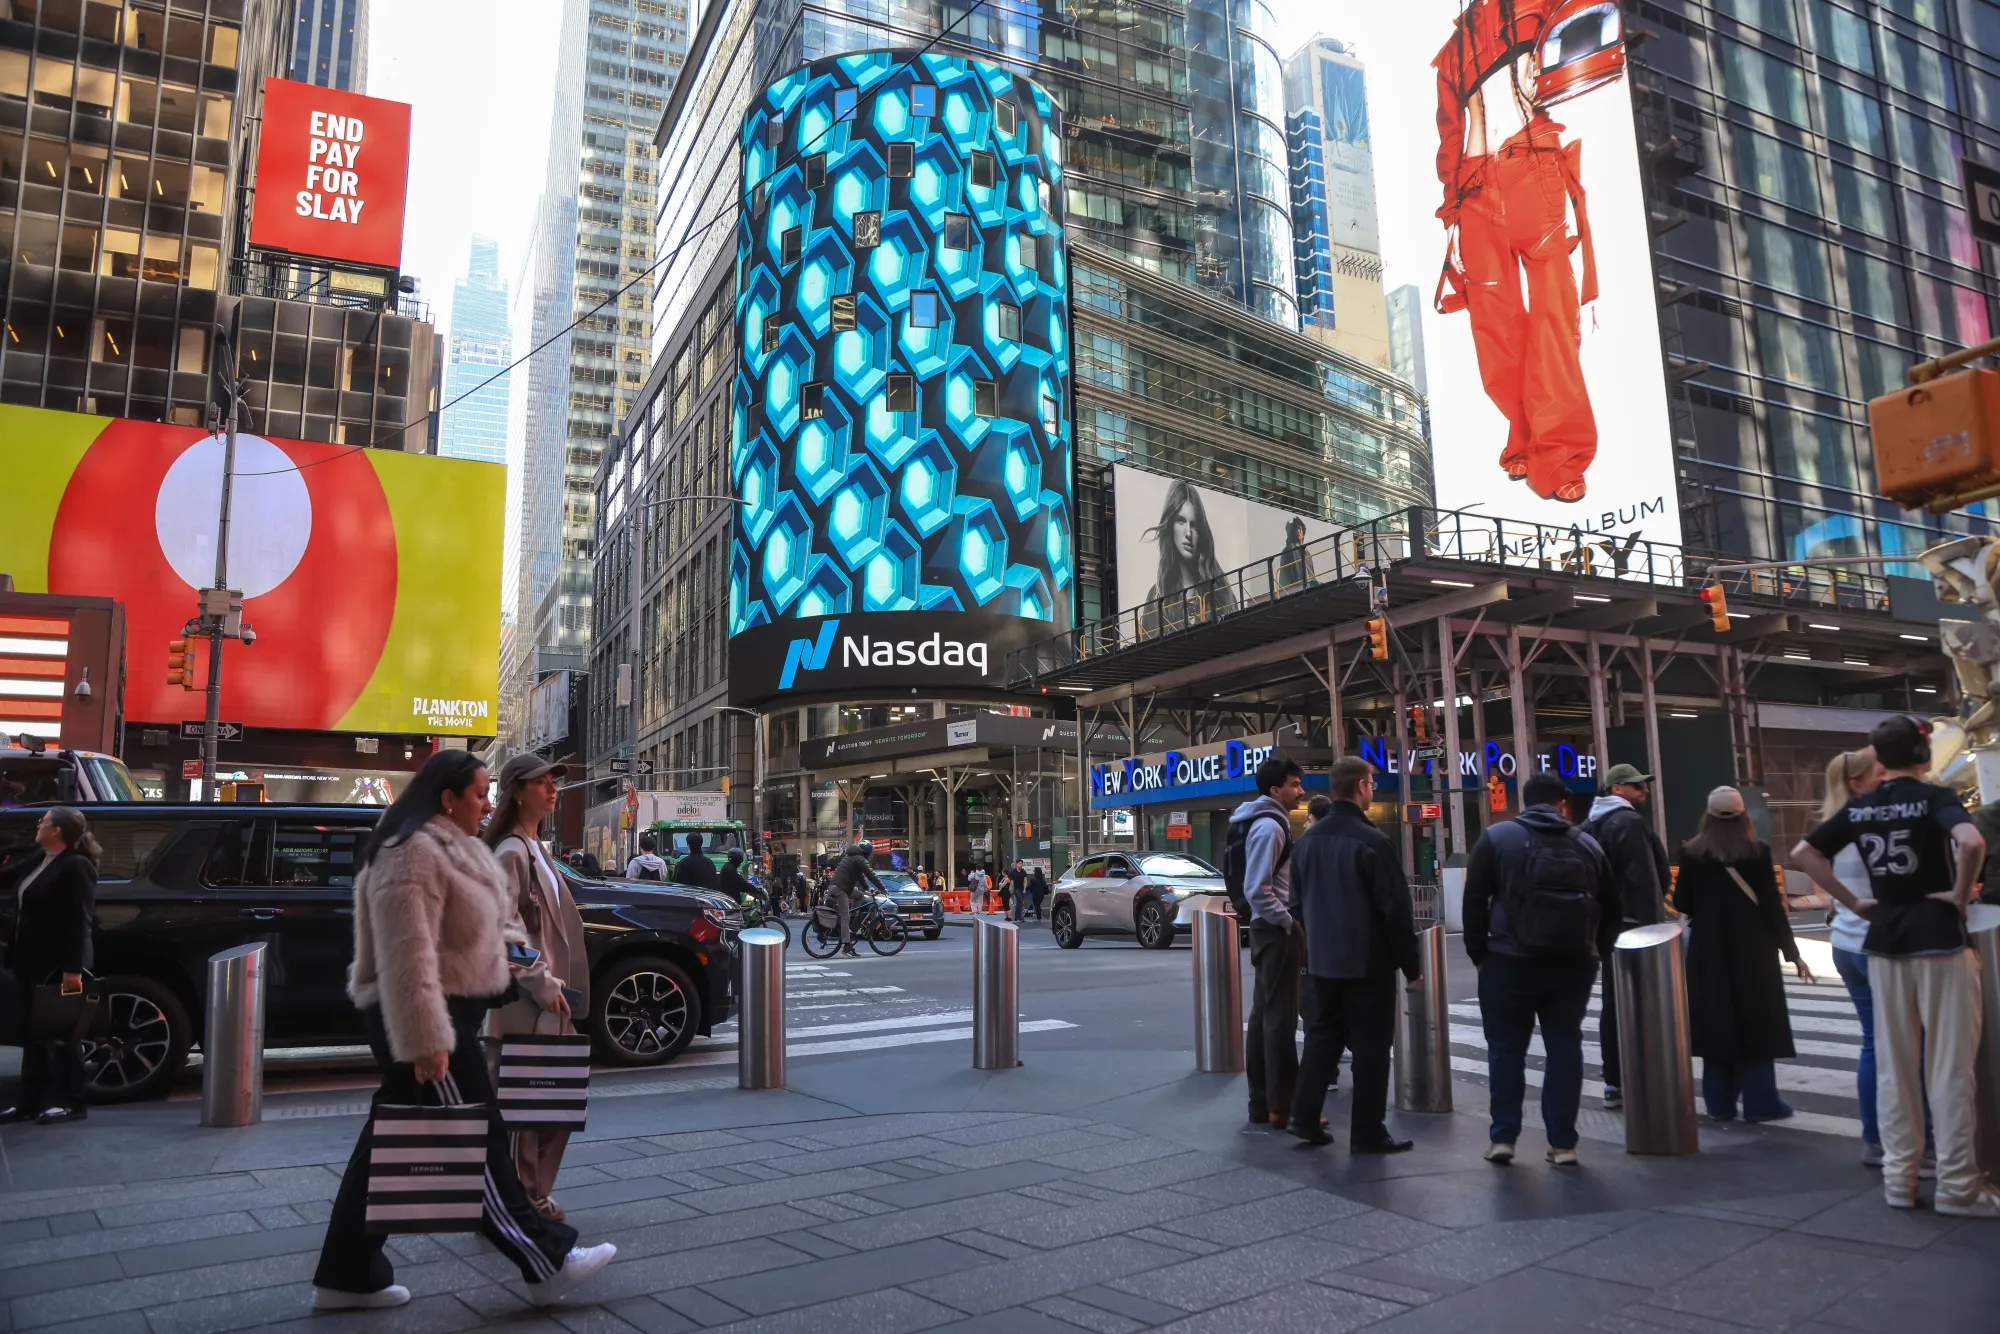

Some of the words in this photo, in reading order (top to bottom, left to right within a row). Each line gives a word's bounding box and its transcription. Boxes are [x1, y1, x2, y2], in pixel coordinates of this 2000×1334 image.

[309, 110, 364, 143] END
[309, 138, 360, 169] PAY
[306, 165, 359, 196] FOR
[295, 191, 365, 224] SLAY
[1502, 528, 1559, 556] NEW
[1567, 496, 1664, 540] ALBUM
[842, 631, 989, 677] Nasdaq
[413, 697, 488, 718] PLANKTON
[427, 716, 443, 727] THE
[445, 716, 473, 728] MOVIE
[858, 740, 872, 748] TODAY
[875, 736, 896, 744] REWRITE
[1090, 763, 1123, 798] NEW
[1122, 758, 1163, 793] YORK
[1166, 751, 1220, 786] POLICE
[1226, 739, 1273, 778] DEPT
[1557, 743, 1597, 778] DEP
[811, 791, 835, 799] branded
[866, 813, 894, 822] Nasdaq
[1848, 800, 1929, 823] ZIMMERMAN
[1859, 829, 1919, 876] 25
